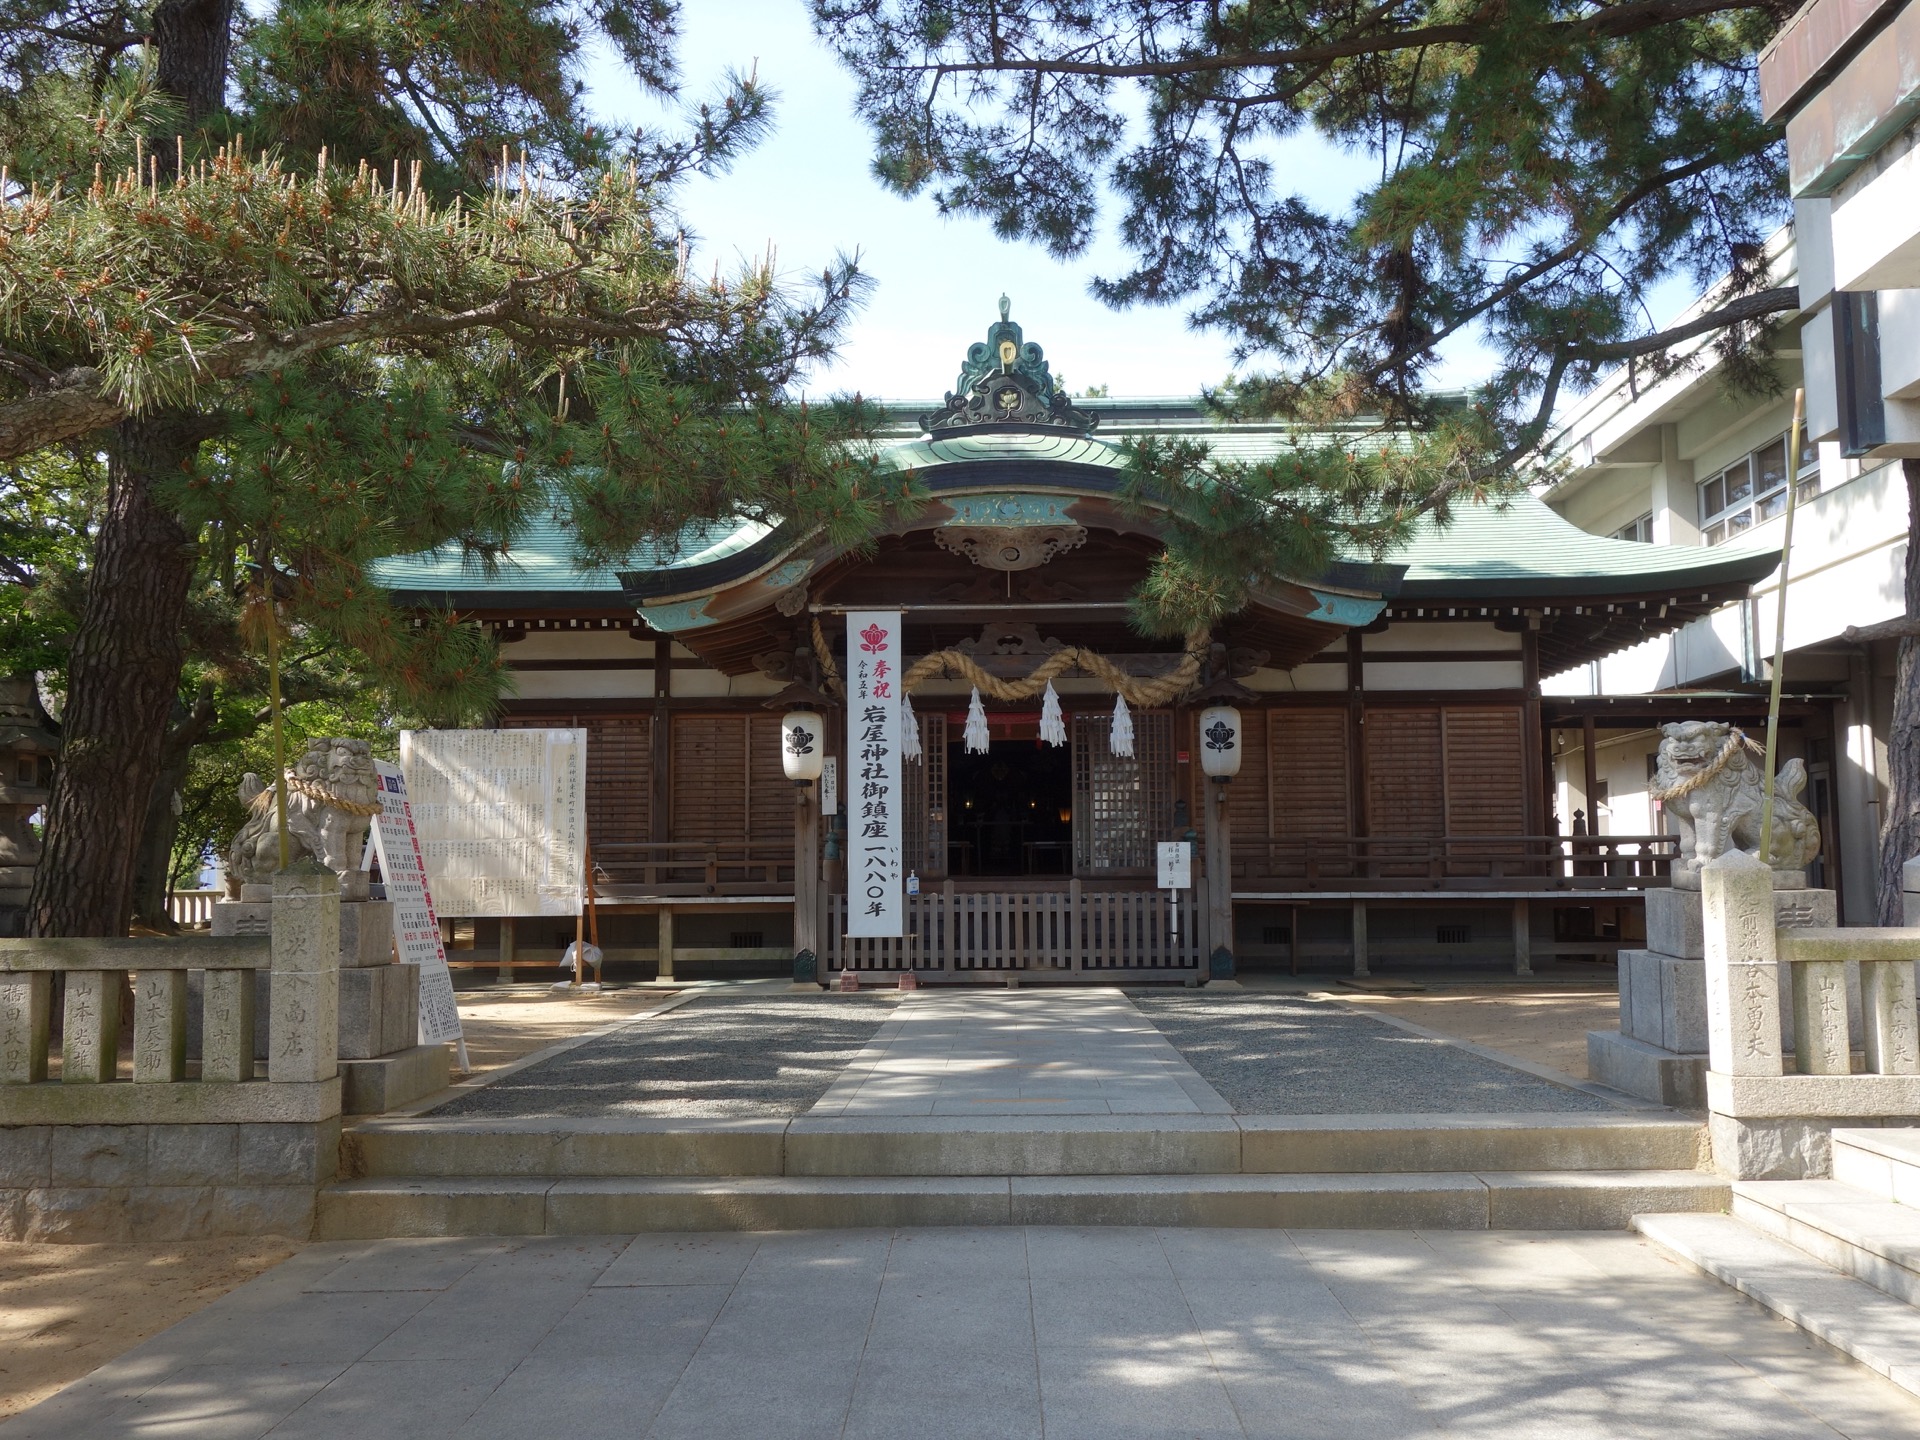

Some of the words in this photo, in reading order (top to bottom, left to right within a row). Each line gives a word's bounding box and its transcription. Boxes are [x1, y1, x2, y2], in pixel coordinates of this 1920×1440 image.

[857, 661, 868, 700] 令和五年
[872, 659, 892, 700] 奉祝
[890, 845, 899, 880] いわや
